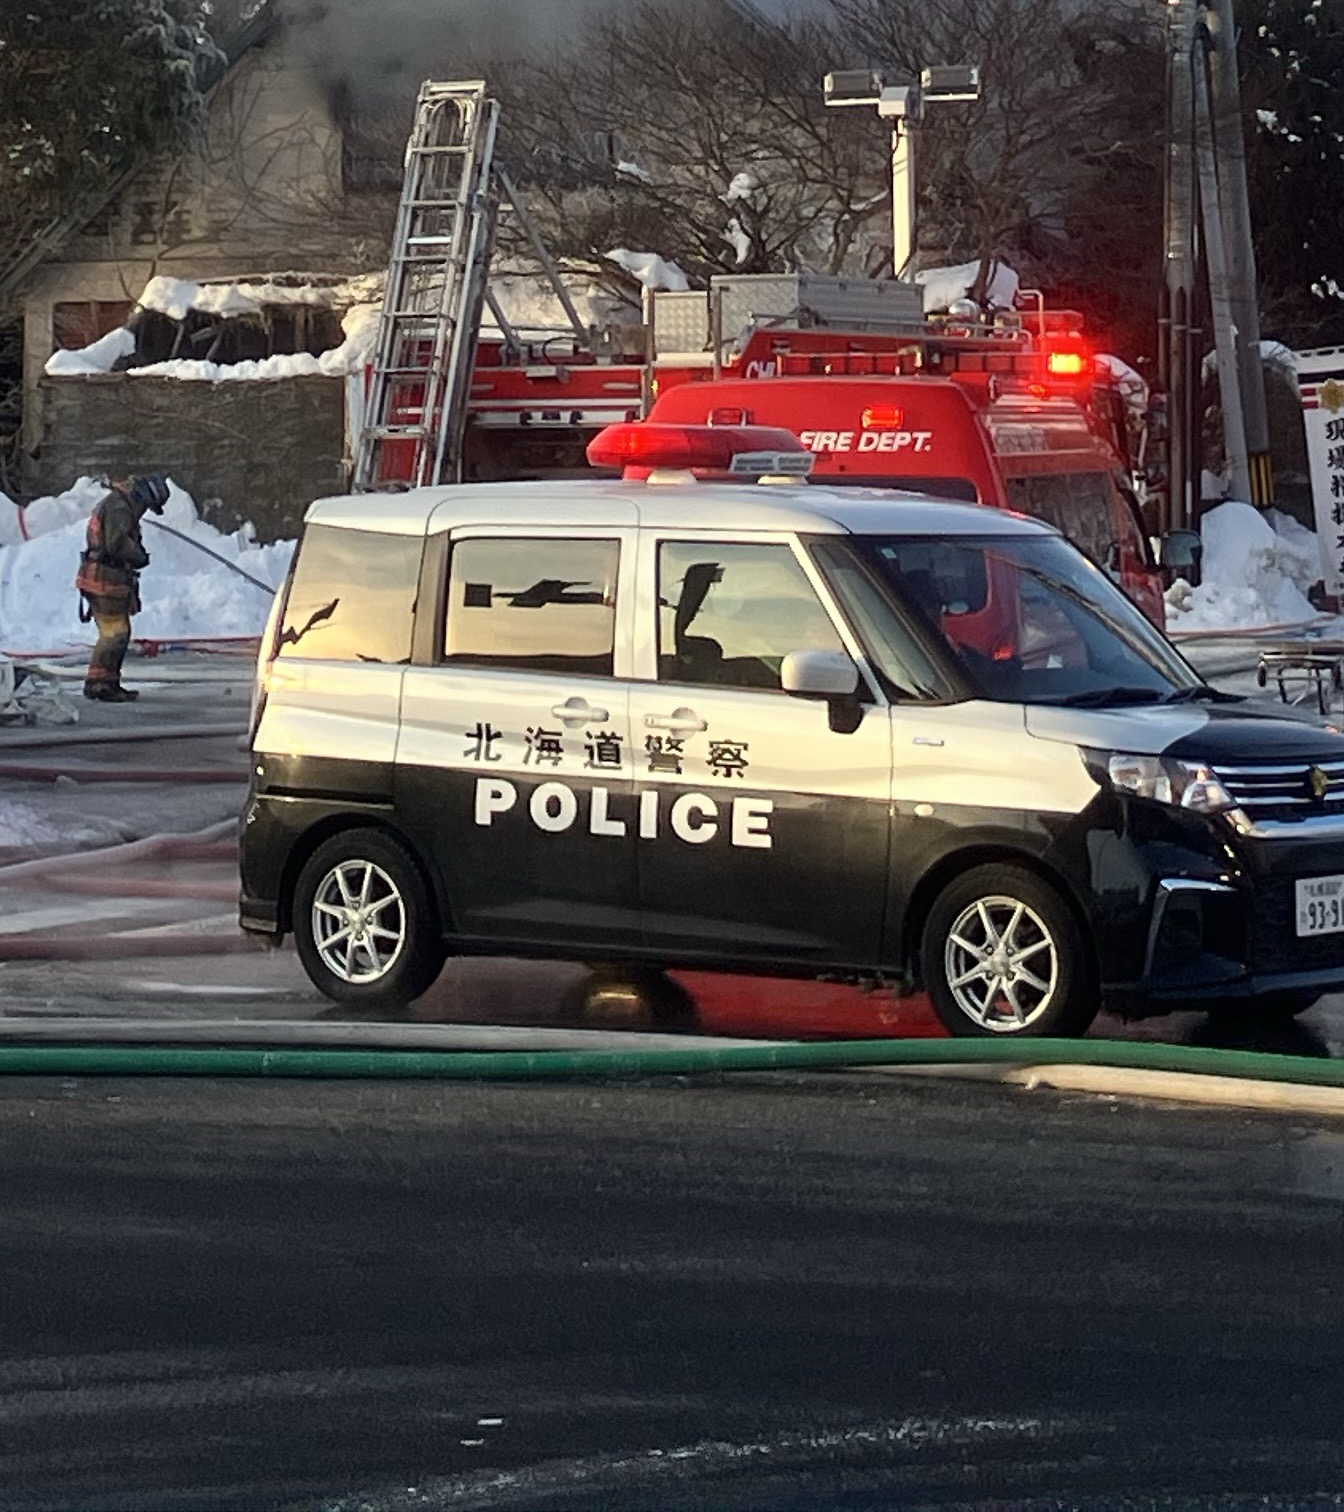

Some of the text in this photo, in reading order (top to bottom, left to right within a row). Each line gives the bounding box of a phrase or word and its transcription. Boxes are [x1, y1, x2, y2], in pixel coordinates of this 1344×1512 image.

[800, 431, 932, 452] FIRE DEPT.
[462, 722, 750, 778] 北海道警察
[474, 777, 775, 849] POLICE
